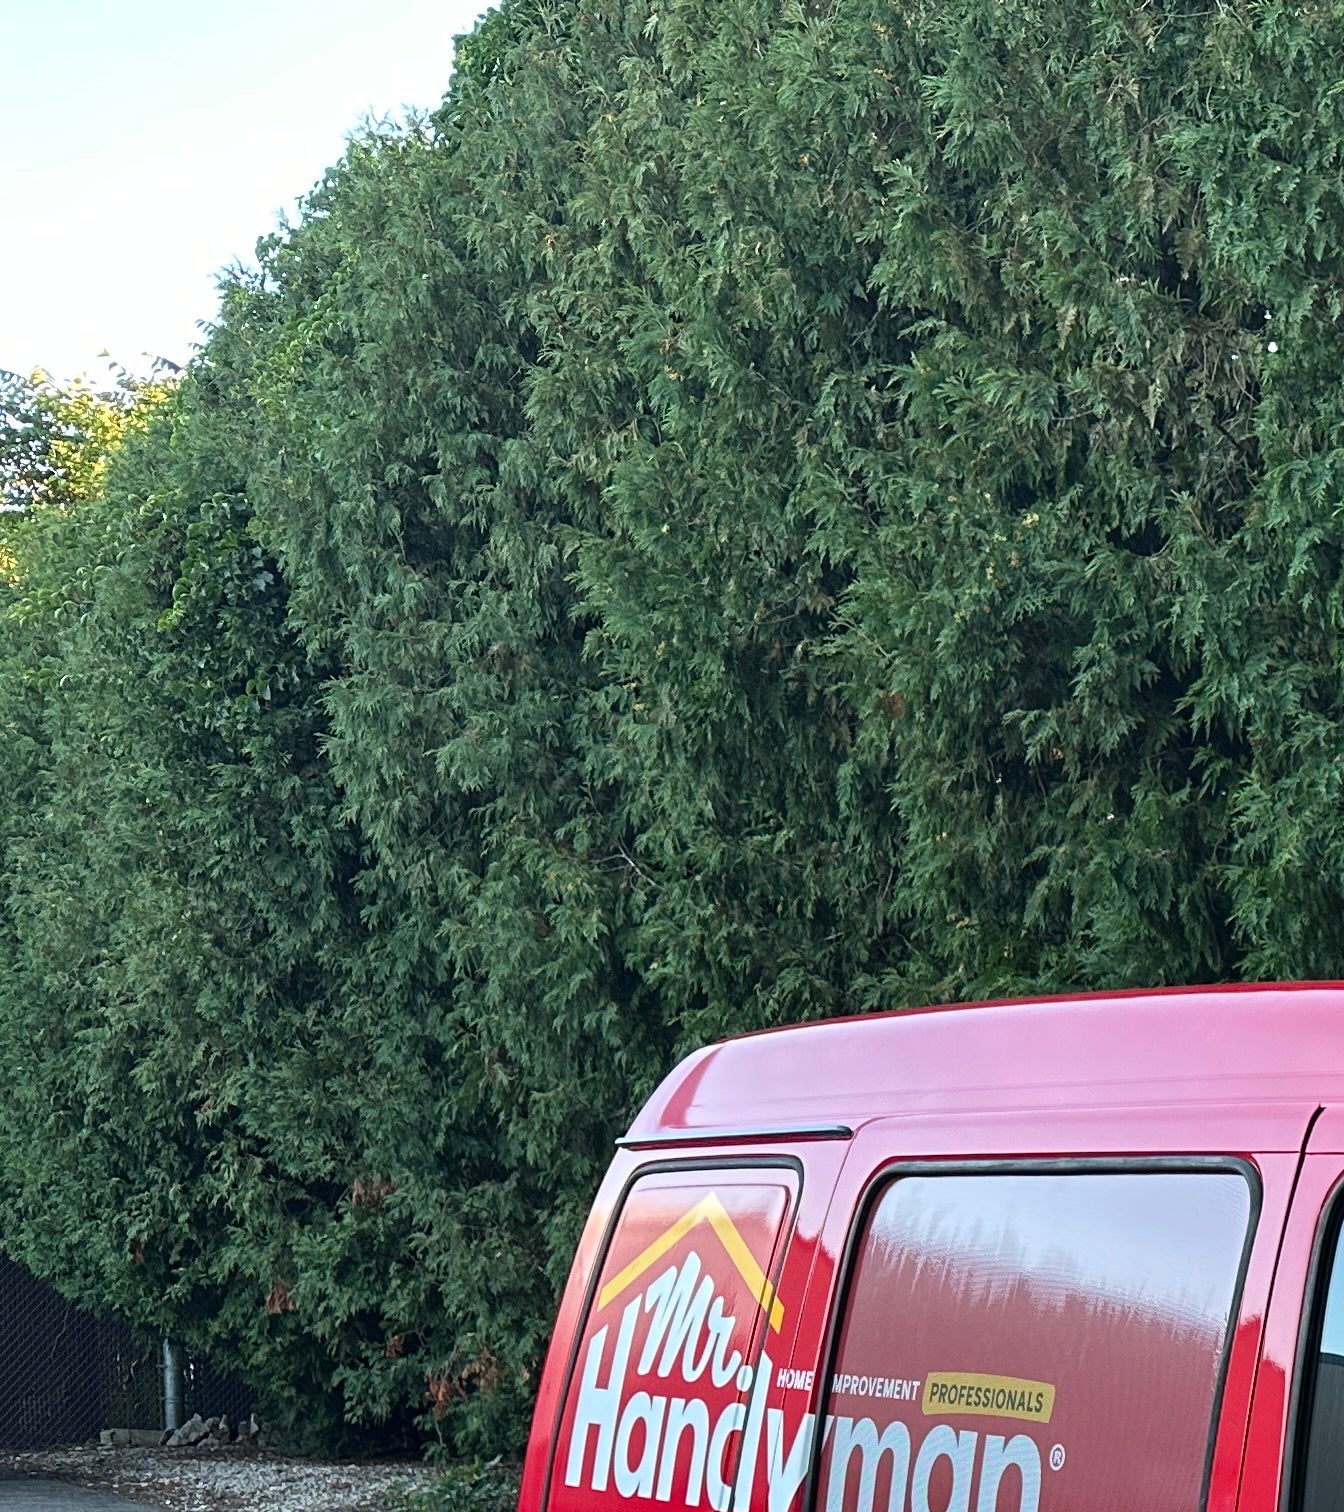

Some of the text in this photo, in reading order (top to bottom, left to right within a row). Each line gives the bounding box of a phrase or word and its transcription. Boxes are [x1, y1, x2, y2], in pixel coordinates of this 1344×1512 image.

[637, 1250, 754, 1392] Mr.
[776, 1368, 1044, 1414] HOME MPROVEMENT PROFESSIONALS
